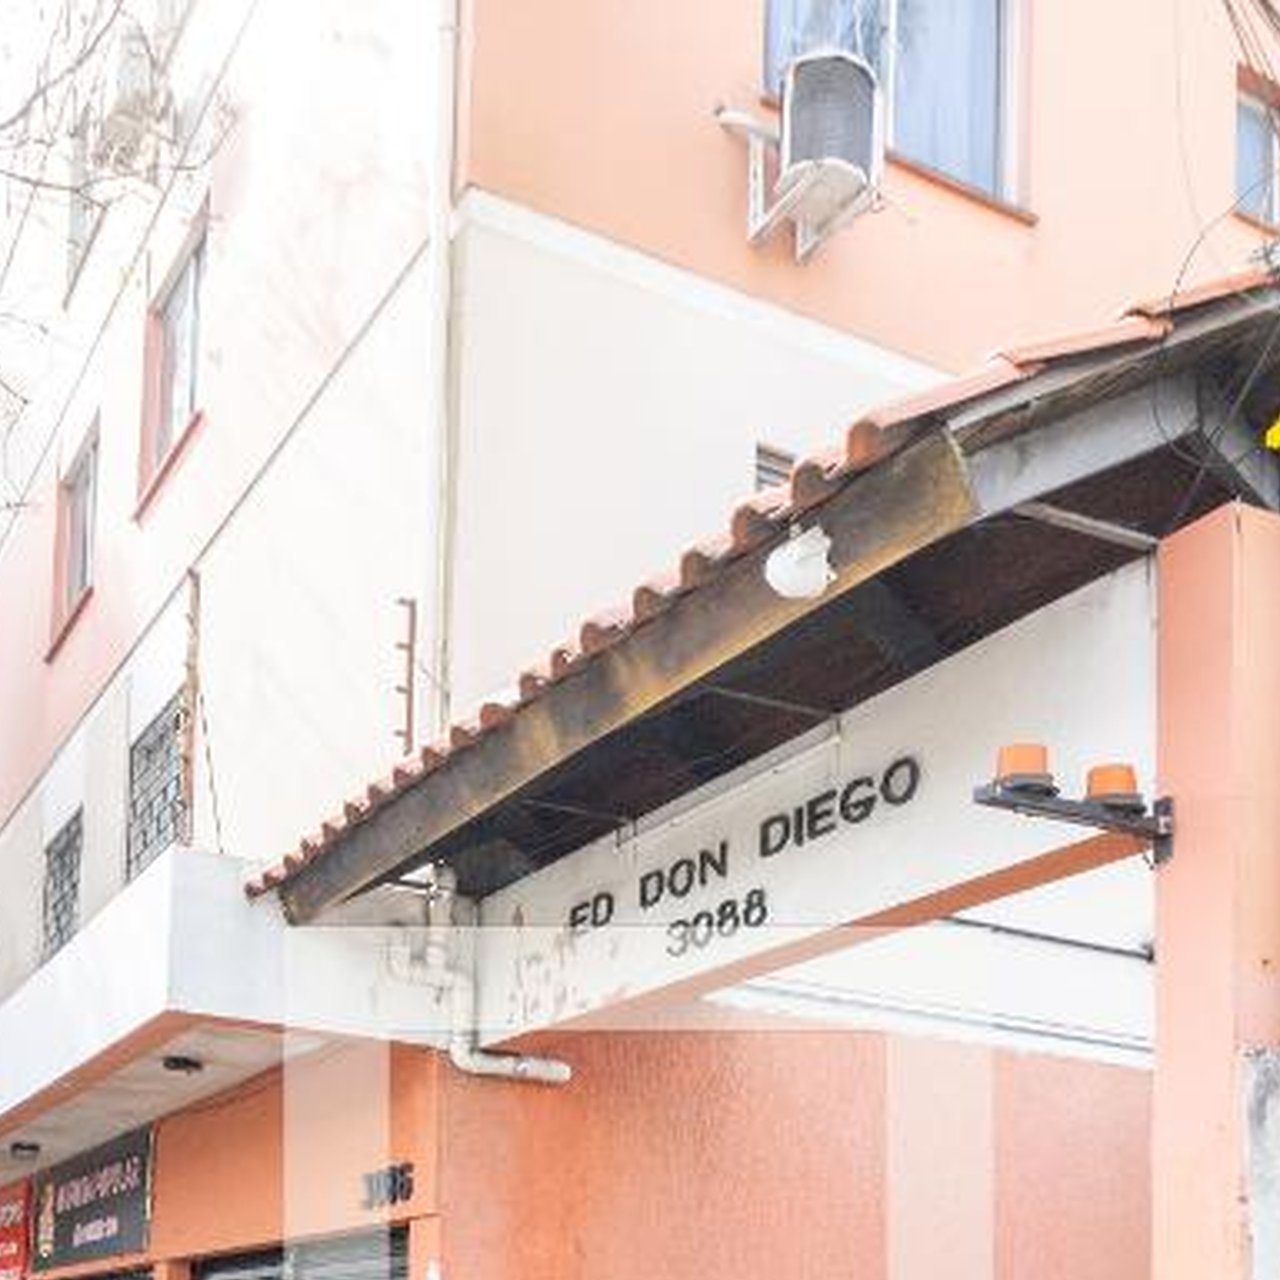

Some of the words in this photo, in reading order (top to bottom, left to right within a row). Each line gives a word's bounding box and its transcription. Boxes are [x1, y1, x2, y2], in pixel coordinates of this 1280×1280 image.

[640, 841, 728, 909] DON
[760, 757, 919, 857] DIEGO
[667, 889, 767, 956] 3088
